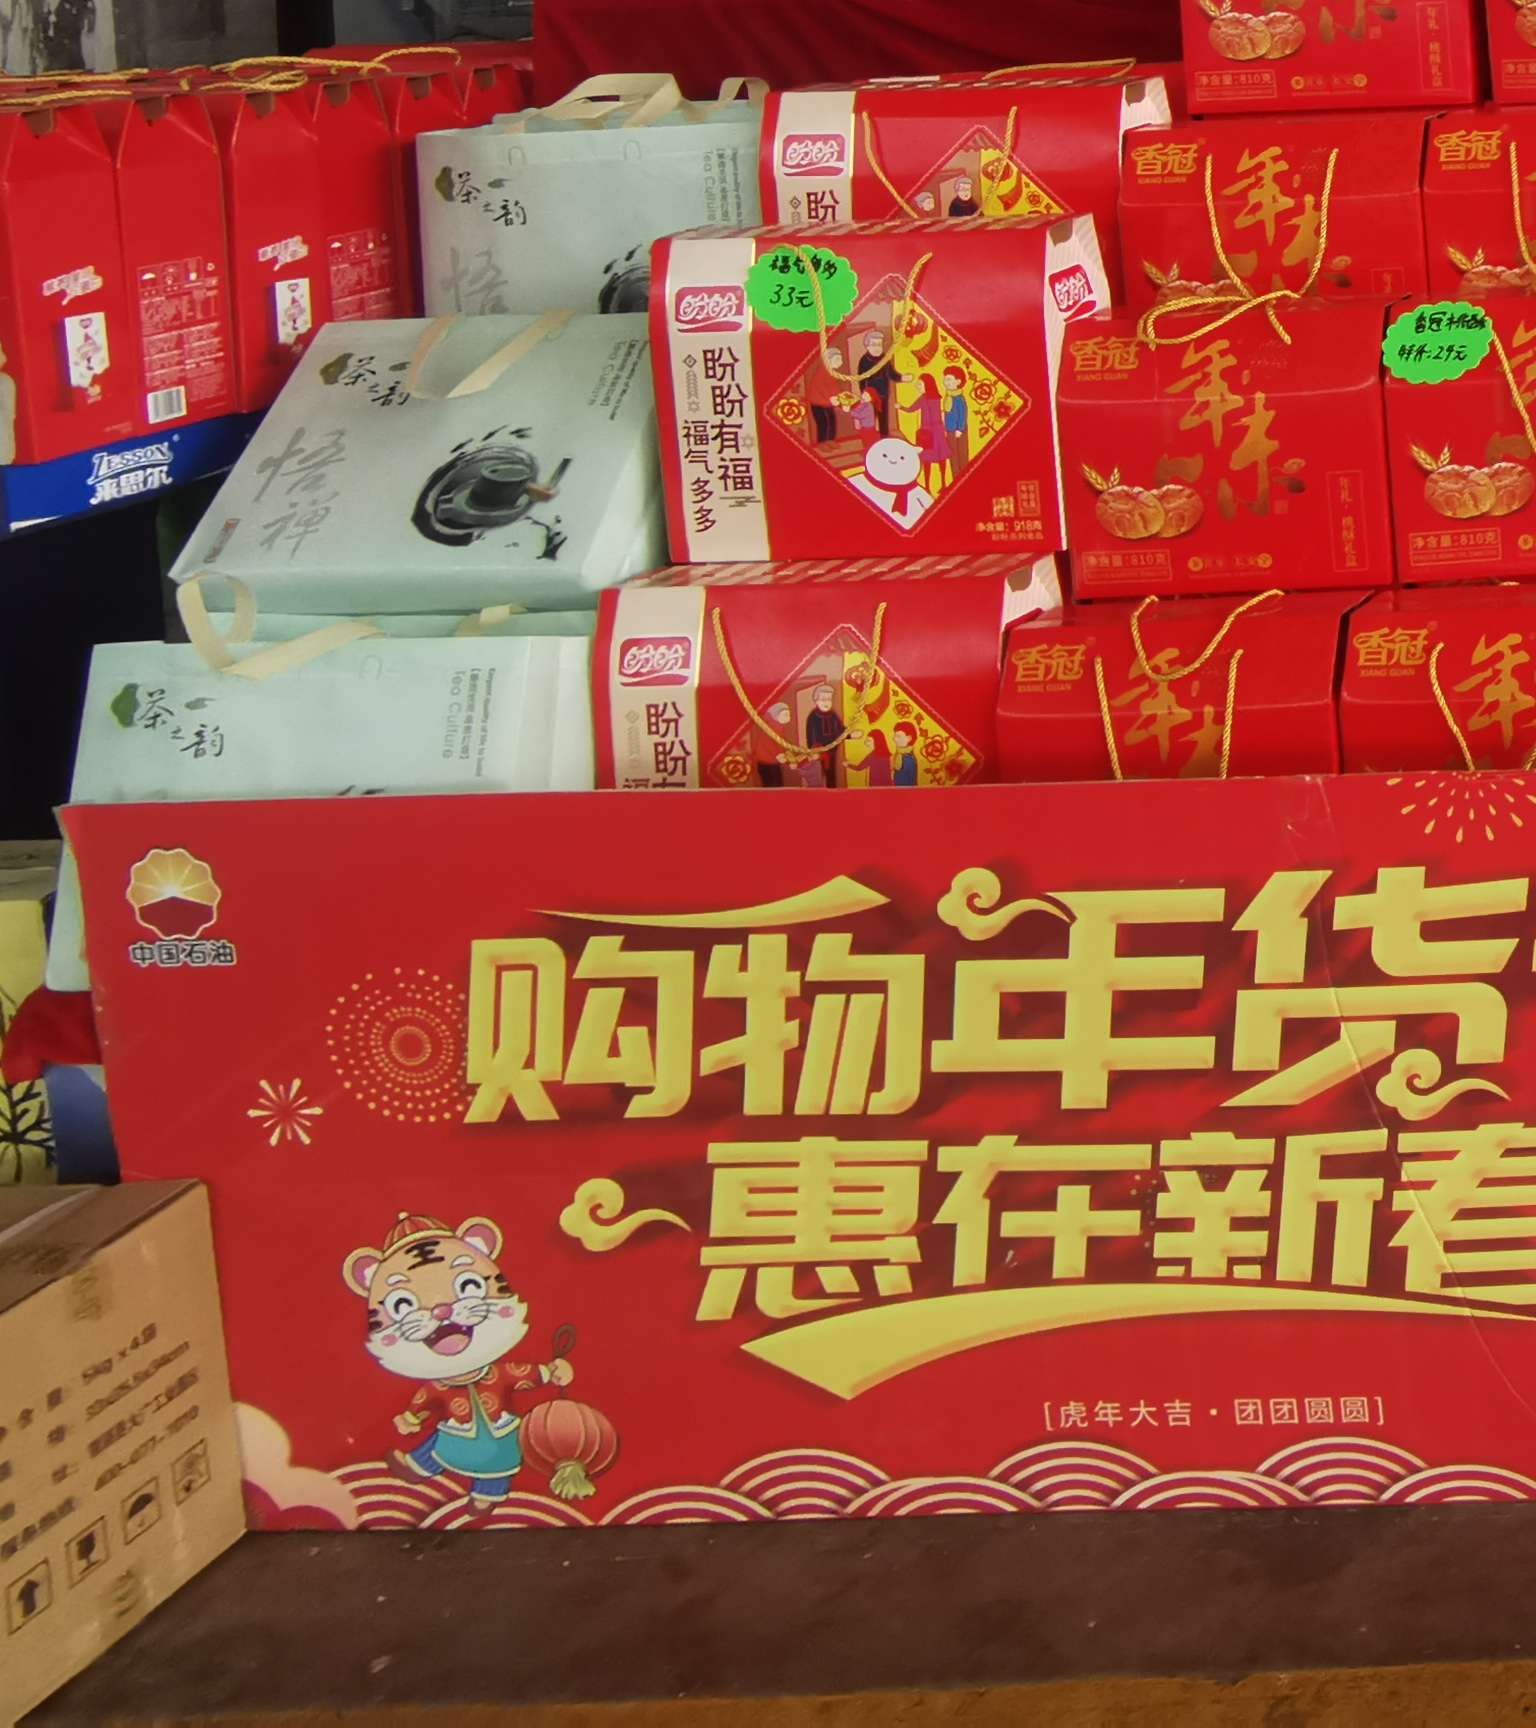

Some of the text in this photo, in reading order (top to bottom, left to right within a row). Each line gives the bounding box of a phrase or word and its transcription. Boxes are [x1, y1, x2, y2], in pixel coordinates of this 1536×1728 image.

[787, 138, 841, 167] 盼盼
[1132, 143, 1198, 175] 香冠
[1434, 129, 1503, 162] 香冠
[455, 171, 528, 227] 茶之韵
[679, 292, 739, 319] 盼盼
[769, 283, 814, 308] 33元
[1070, 335, 1139, 370] 香冠
[701, 345, 755, 493] 盼盼有福
[89, 463, 173, 505] 来思尔
[681, 418, 718, 534] 福气多多
[1412, 532, 1498, 549] 净含量:810克
[622, 643, 687, 672] 盼盼
[1011, 643, 1087, 682] 香冠
[1353, 627, 1429, 667] 香冠
[139, 688, 224, 760] 茶之韵
[128, 938, 236, 968] 中国石油
